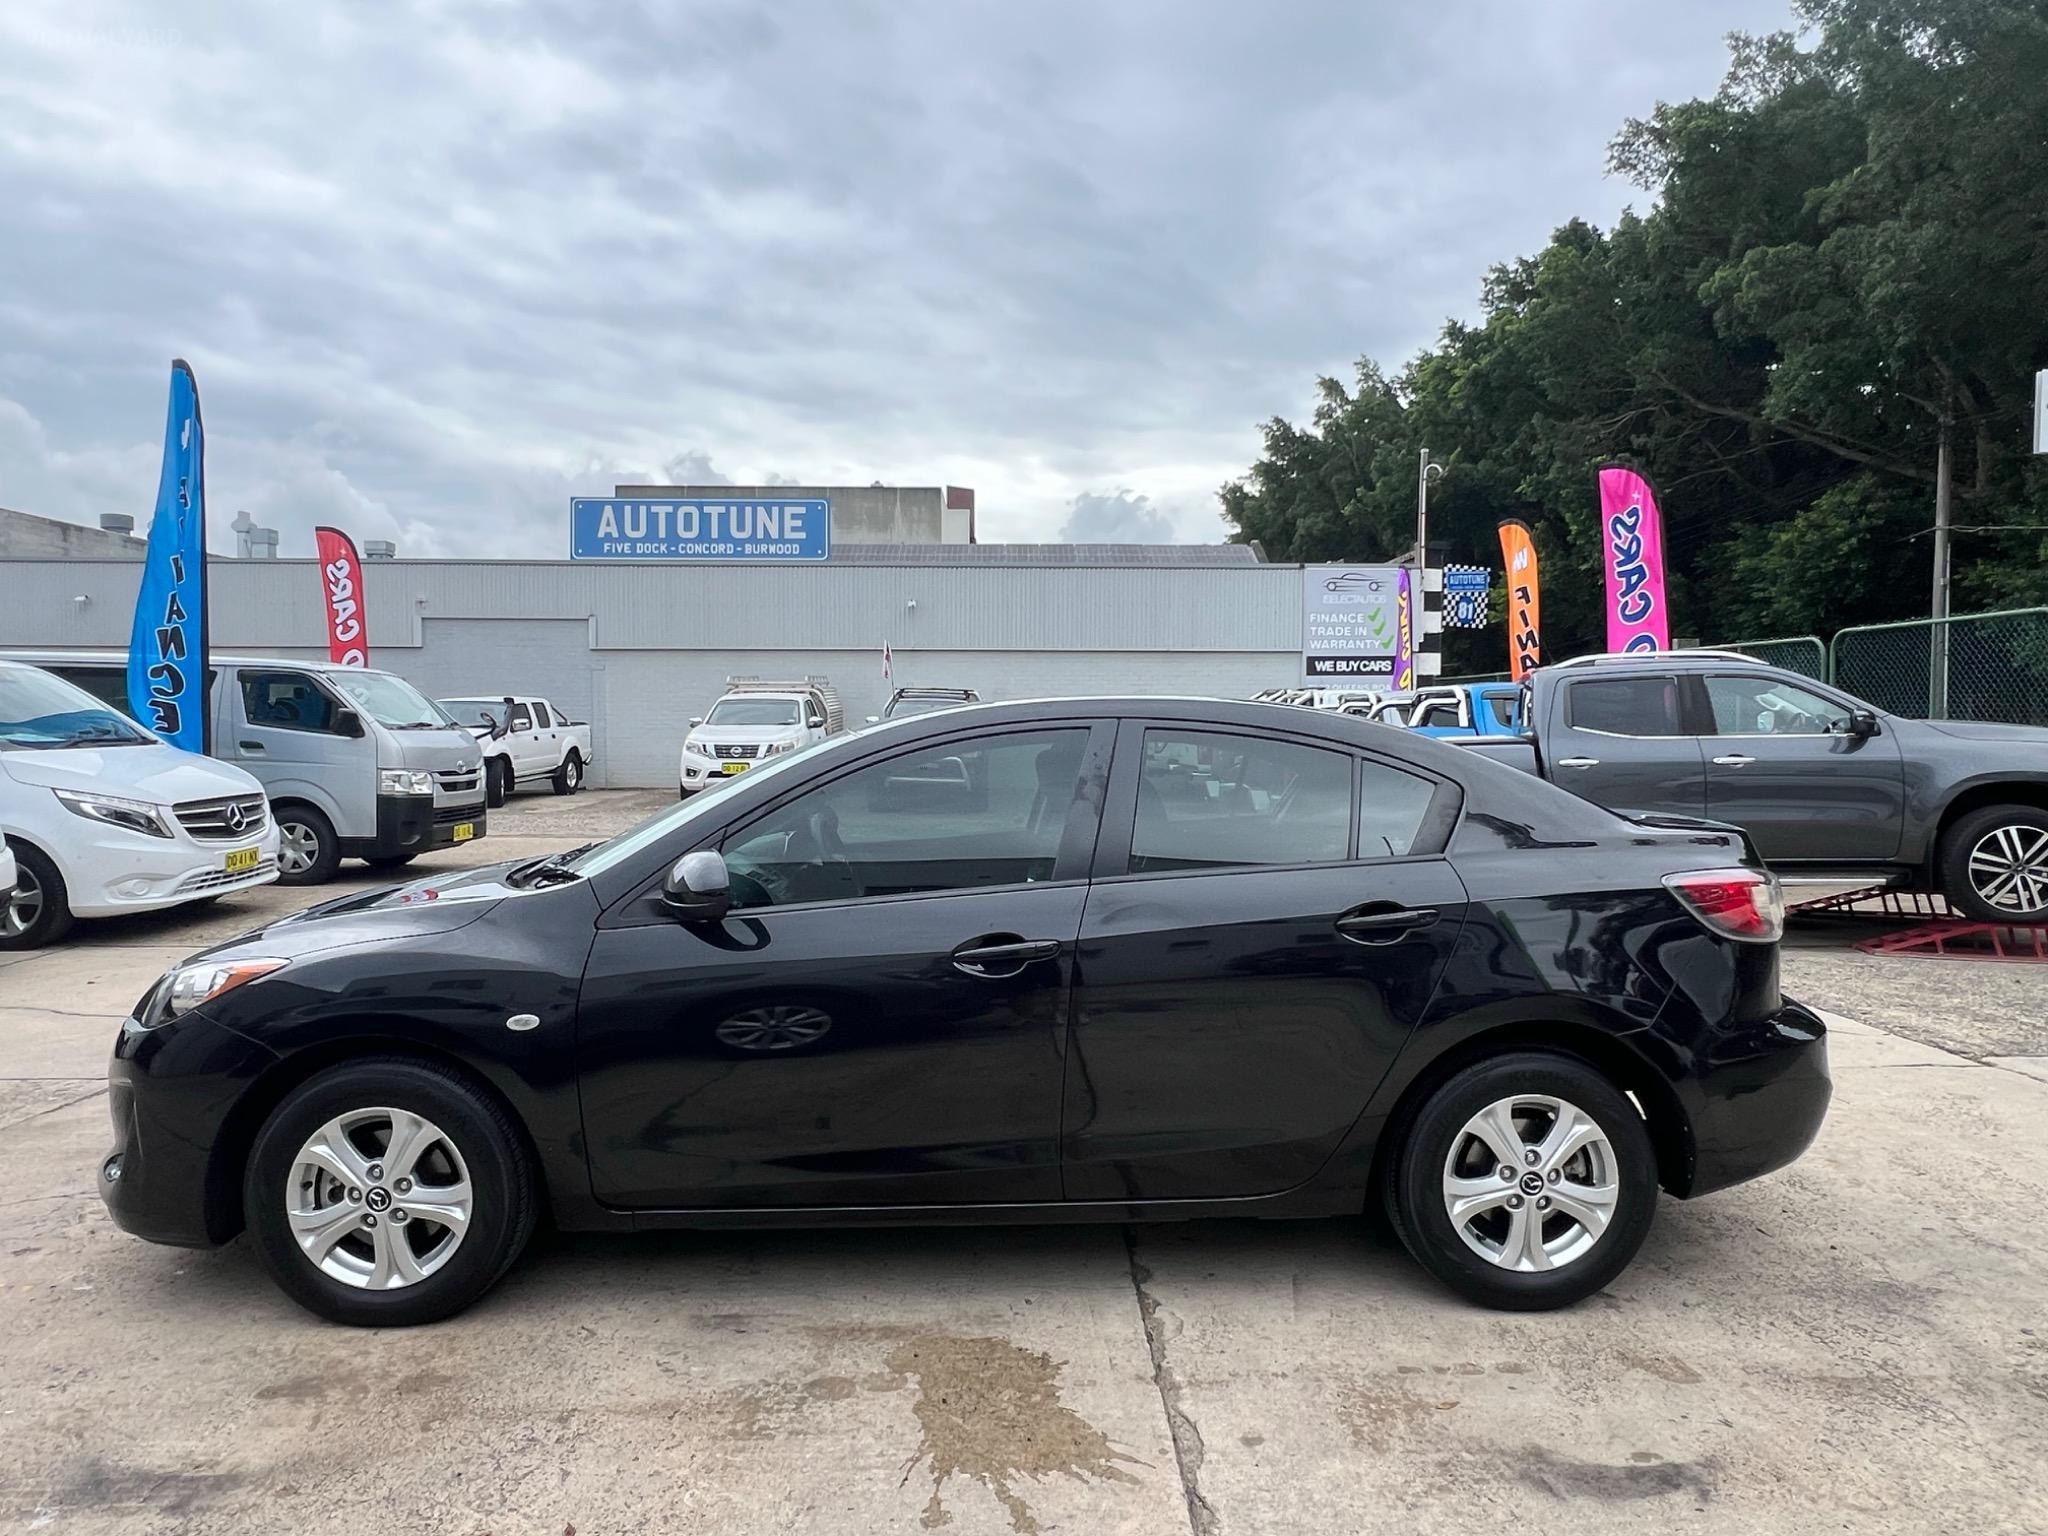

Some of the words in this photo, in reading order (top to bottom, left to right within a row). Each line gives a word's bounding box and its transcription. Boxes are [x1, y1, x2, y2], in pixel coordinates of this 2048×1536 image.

[597, 505, 807, 540] AUTOTUNE
[603, 542, 632, 554] FIVE
[1449, 574, 1486, 585] AUTOTUNE
[1457, 602, 1474, 620] 81
[1310, 613, 1365, 623] FINANCE
[1310, 626, 1351, 636] TRADE
[1355, 627, 1368, 636] IN
[1310, 639, 1381, 649] WARRANTY
[1314, 660, 1335, 672] WE
[1336, 660, 1360, 672] BUY
[1360, 660, 1392, 672] CARS
